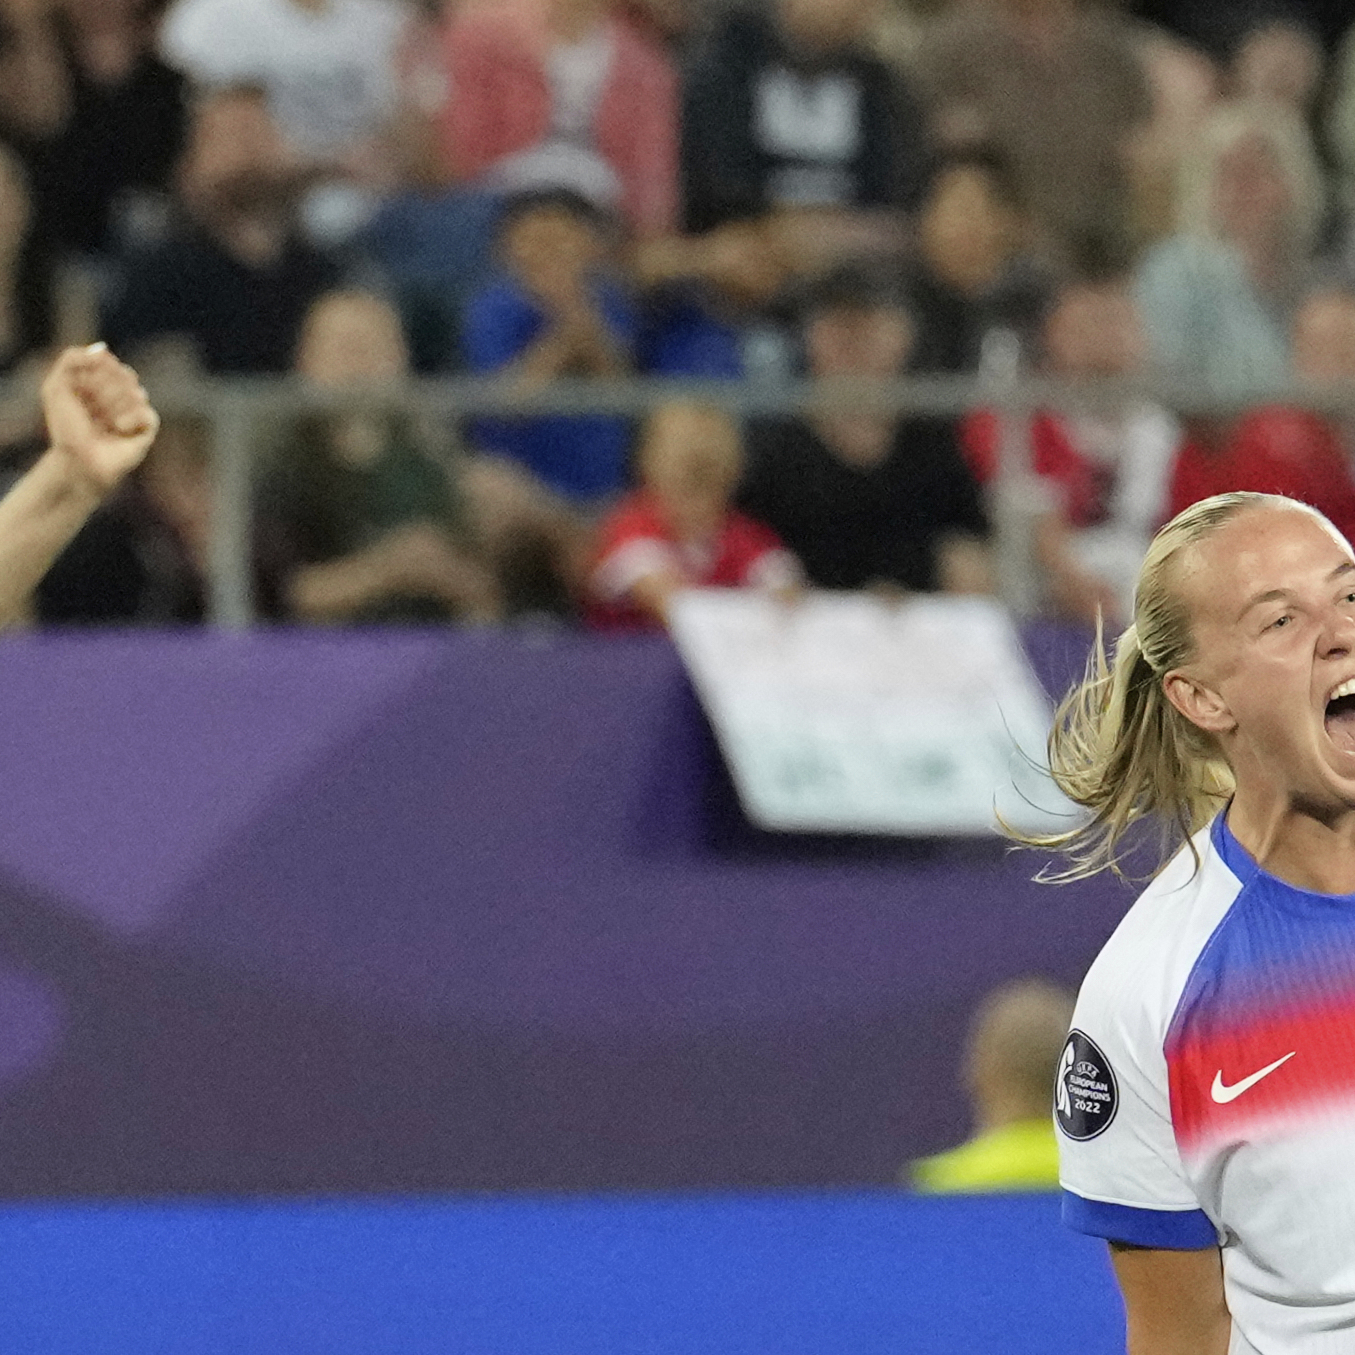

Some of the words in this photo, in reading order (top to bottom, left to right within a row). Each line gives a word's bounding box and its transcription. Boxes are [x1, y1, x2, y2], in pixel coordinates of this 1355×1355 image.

[1070, 1074, 1108, 1092] EUROPEAN
[1068, 1083, 1111, 1103] CHAMPIONS
[1075, 1098, 1101, 1114] 2022
